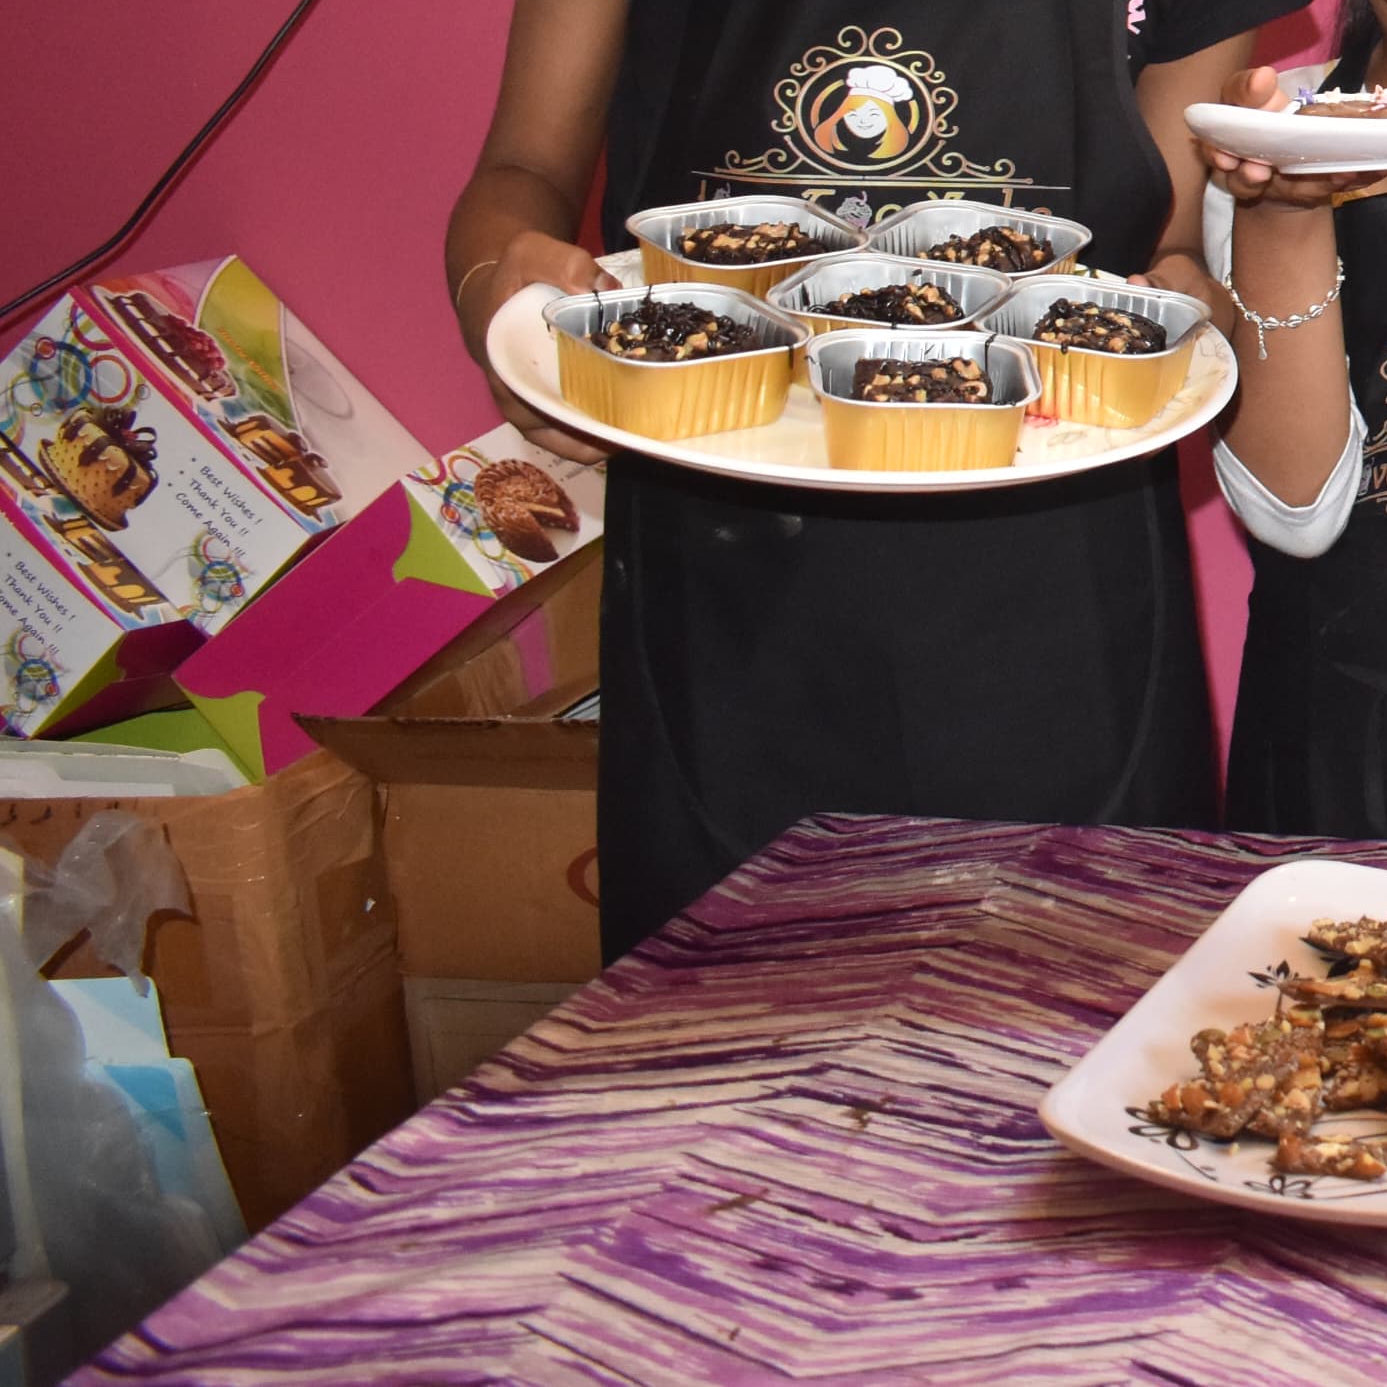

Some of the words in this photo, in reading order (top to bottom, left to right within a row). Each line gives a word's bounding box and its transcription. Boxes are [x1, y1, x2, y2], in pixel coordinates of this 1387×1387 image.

[190, 478, 219, 509] Thank
[220, 508, 238, 529] You
[200, 466, 223, 488] Best
[223, 487, 256, 519] Wishes
[175, 492, 203, 519] Come
[203, 520, 231, 548] Again
[5, 574, 33, 606] Thank
[34, 603, 52, 625] You
[15, 561, 37, 583] Best
[37, 582, 69, 615] Wishes
[0, 589, 18, 616] ome
[18, 616, 45, 645] Again
